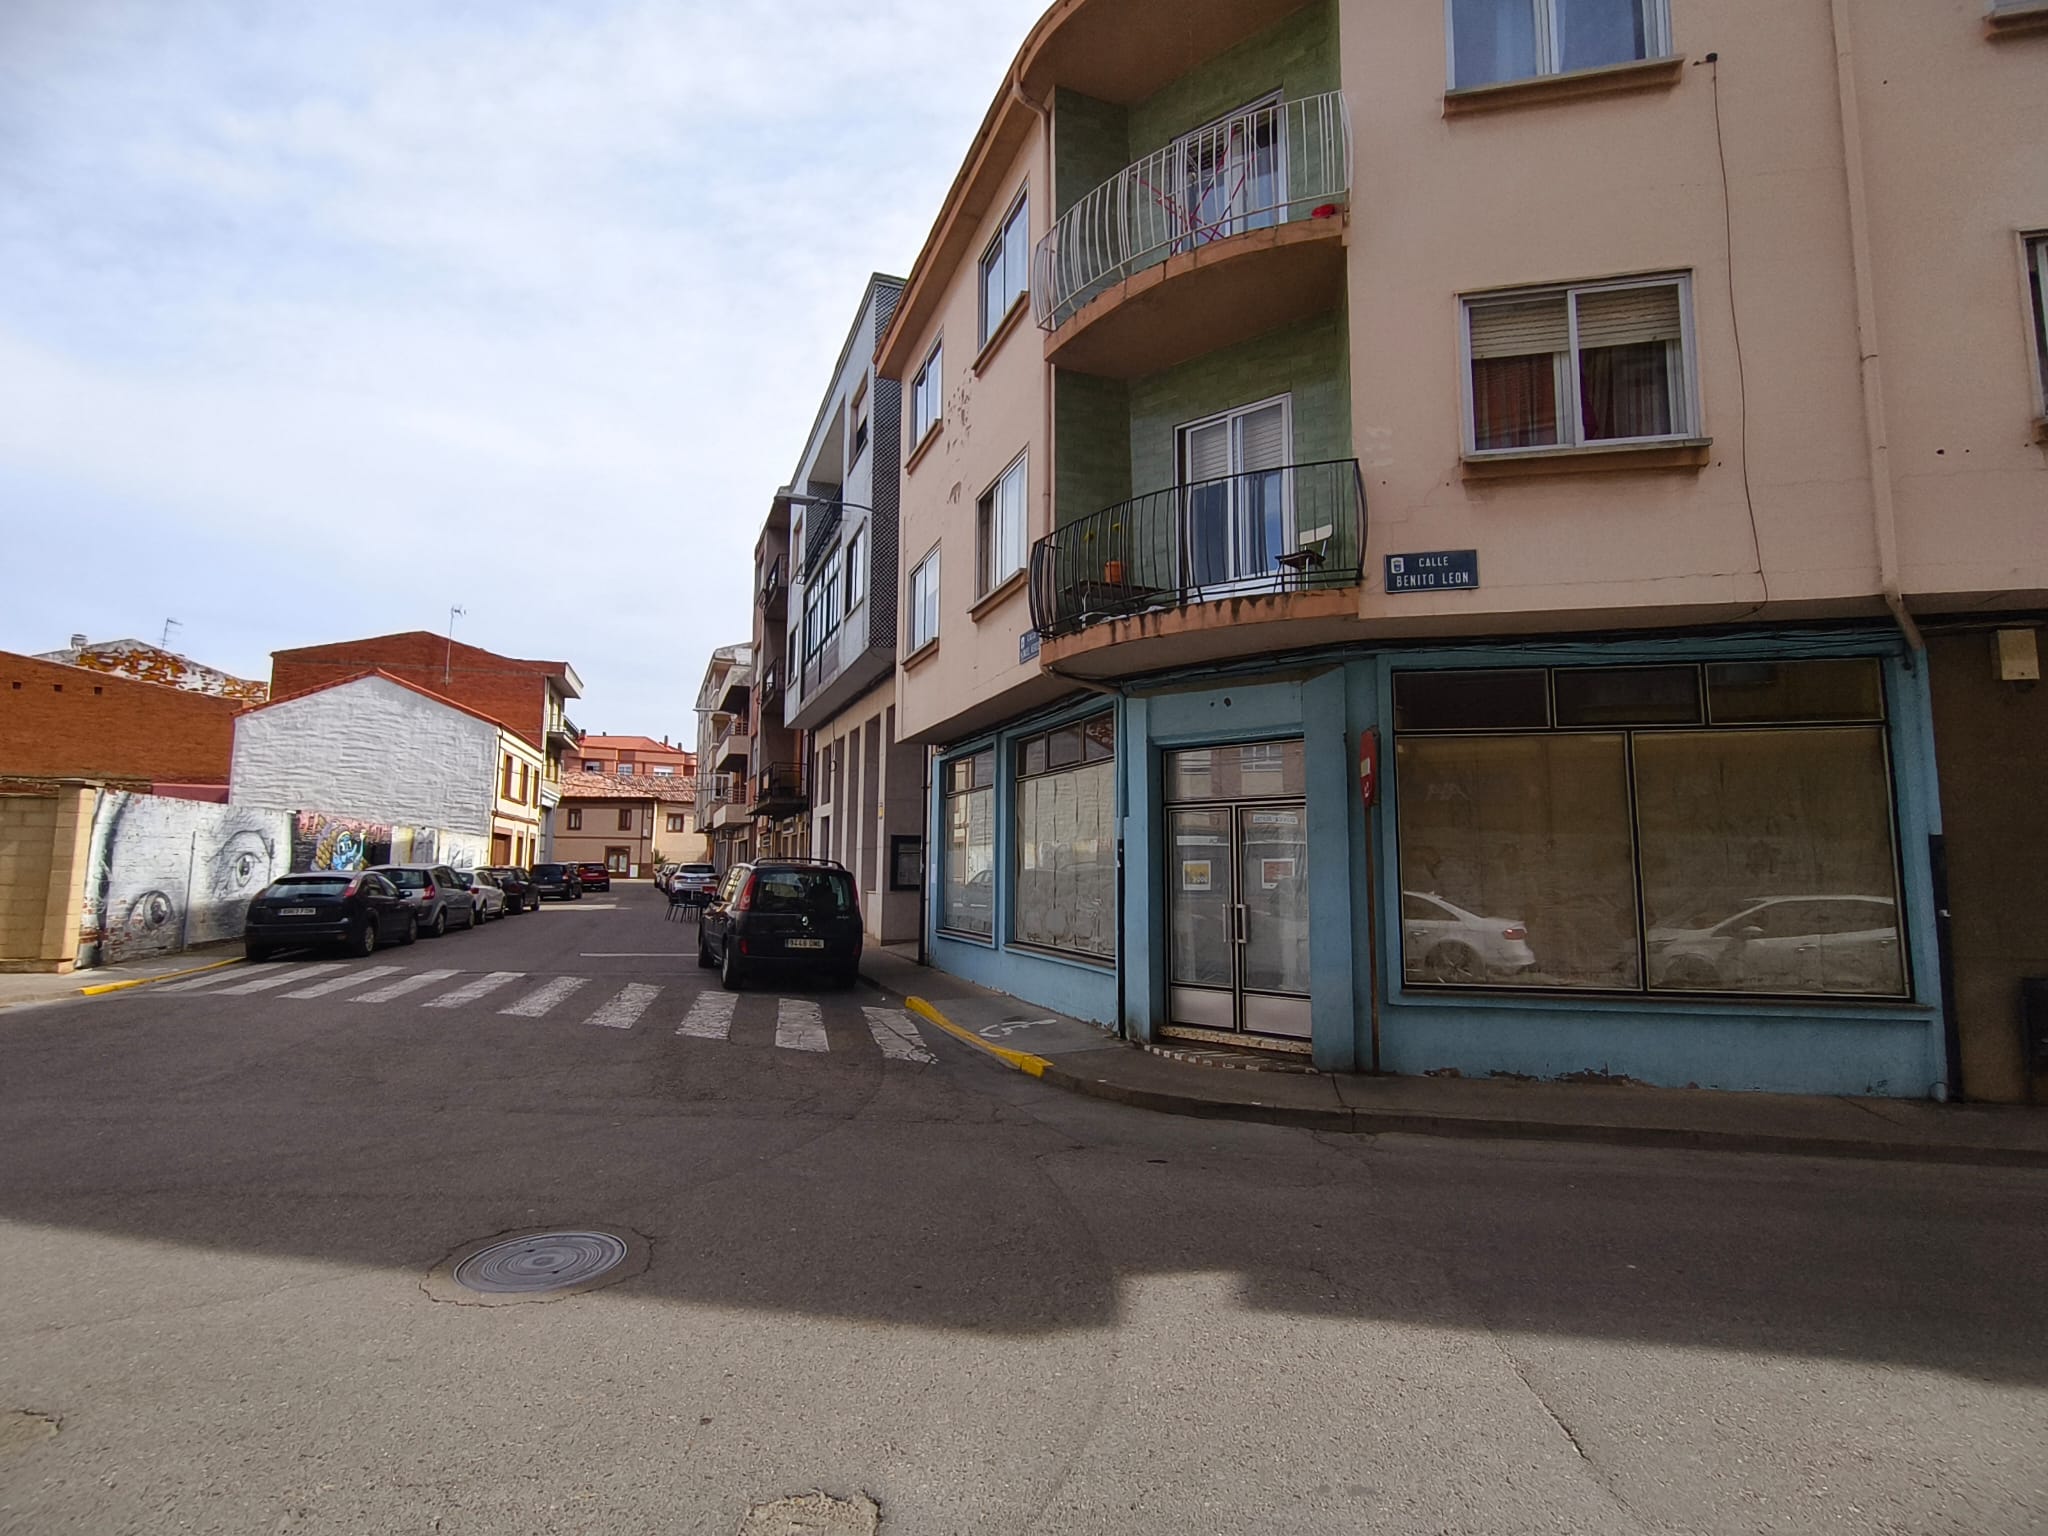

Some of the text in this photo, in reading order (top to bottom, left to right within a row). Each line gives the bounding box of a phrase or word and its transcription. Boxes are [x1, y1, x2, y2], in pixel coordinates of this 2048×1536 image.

[1418, 556, 1449, 567] CALLE
[1396, 571, 1469, 587] BENITO LEON
